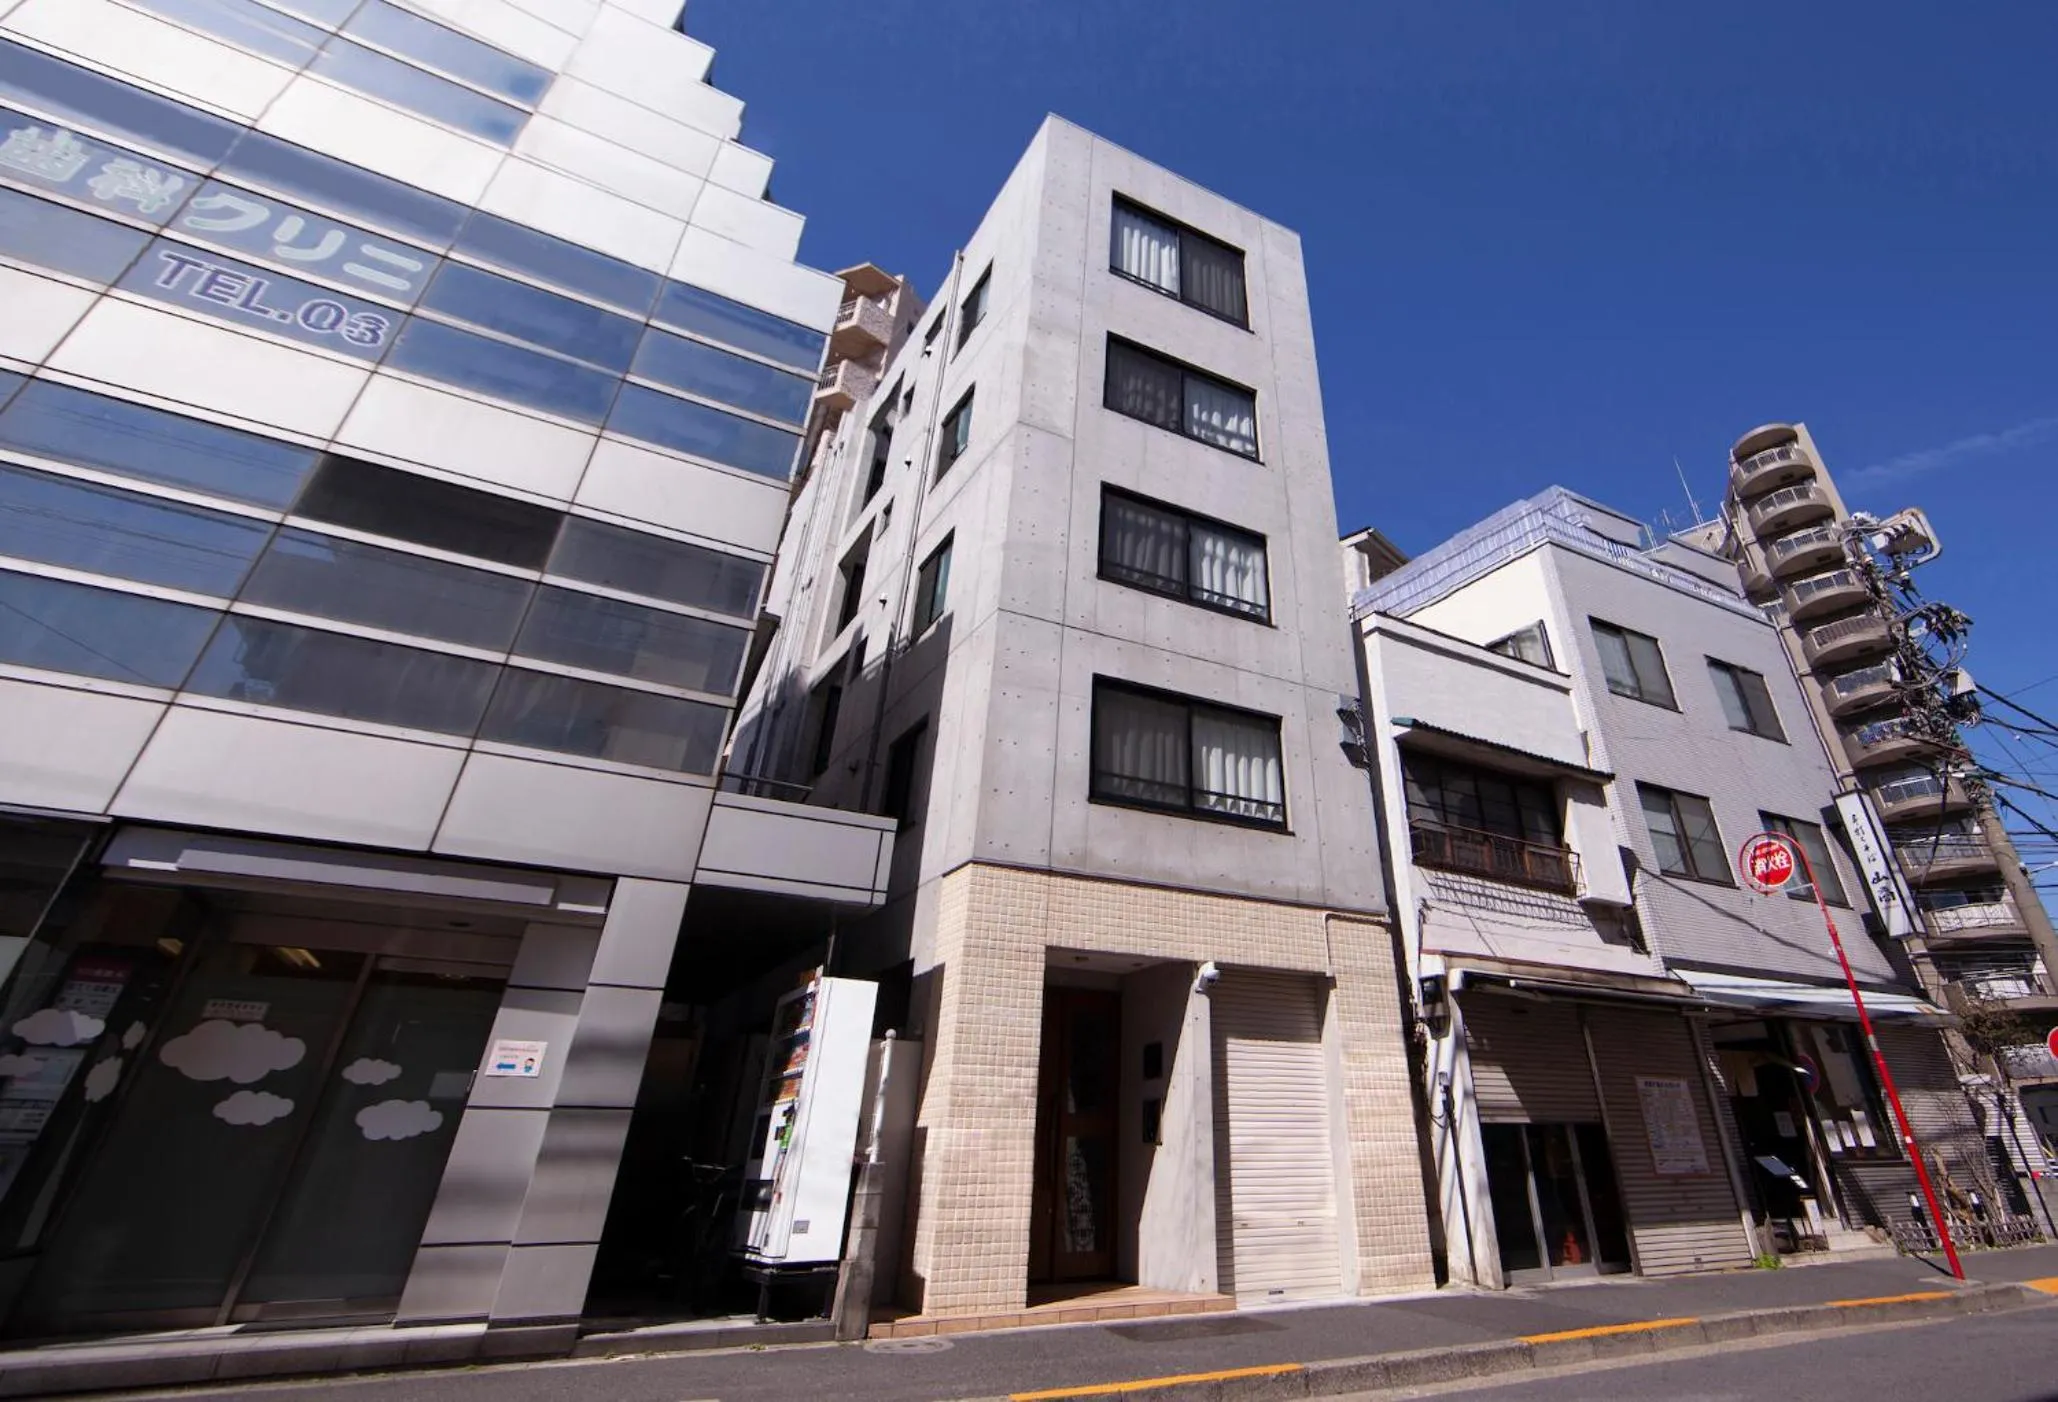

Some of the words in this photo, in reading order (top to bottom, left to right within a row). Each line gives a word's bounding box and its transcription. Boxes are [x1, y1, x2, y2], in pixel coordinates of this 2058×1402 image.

[153, 249, 391, 348] TEL.03
[1754, 850, 1791, 875] 消火栓
